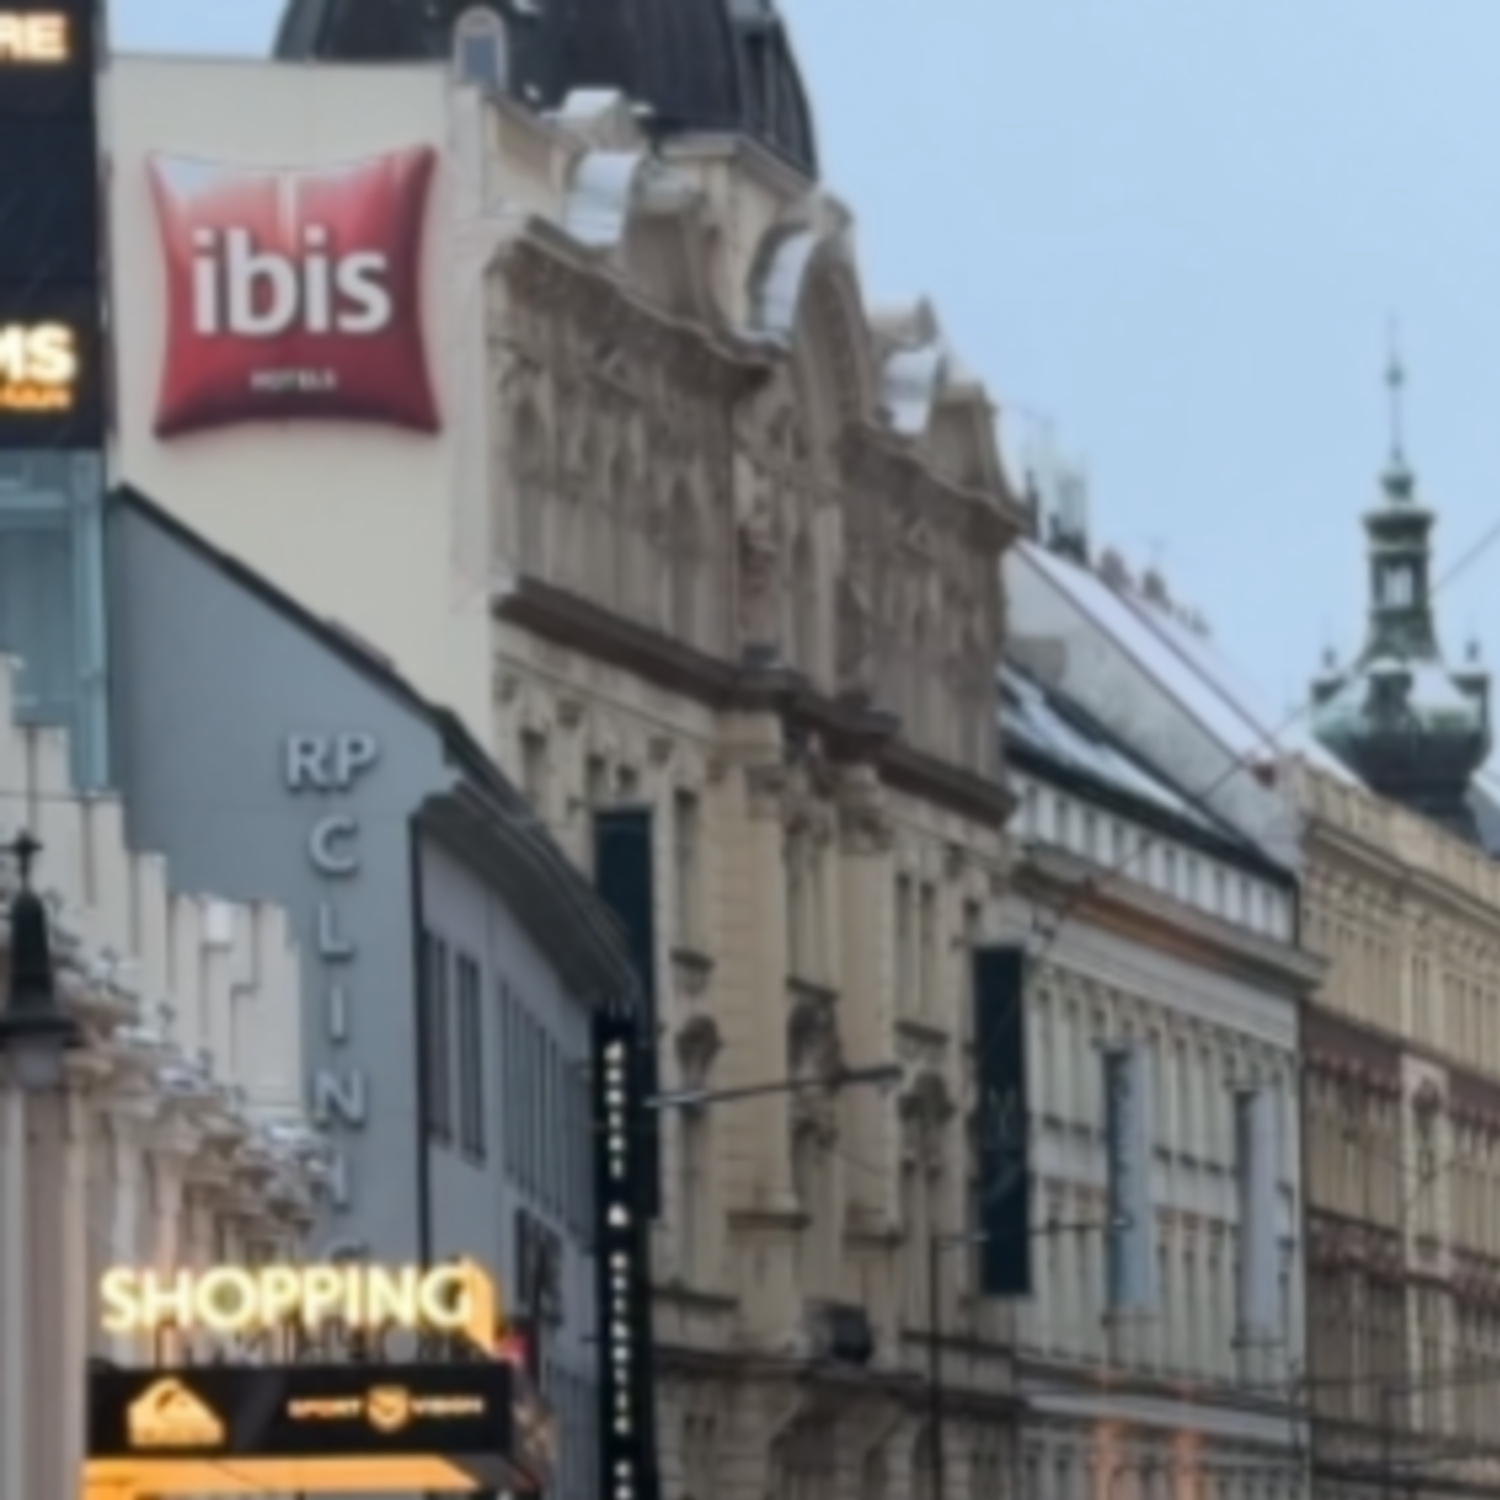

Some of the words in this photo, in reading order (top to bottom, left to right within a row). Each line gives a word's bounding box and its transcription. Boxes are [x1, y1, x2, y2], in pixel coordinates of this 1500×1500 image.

[192, 226, 392, 336] ibis
[286, 732, 377, 790] RP
[99, 1264, 473, 1330] SHOPPING
